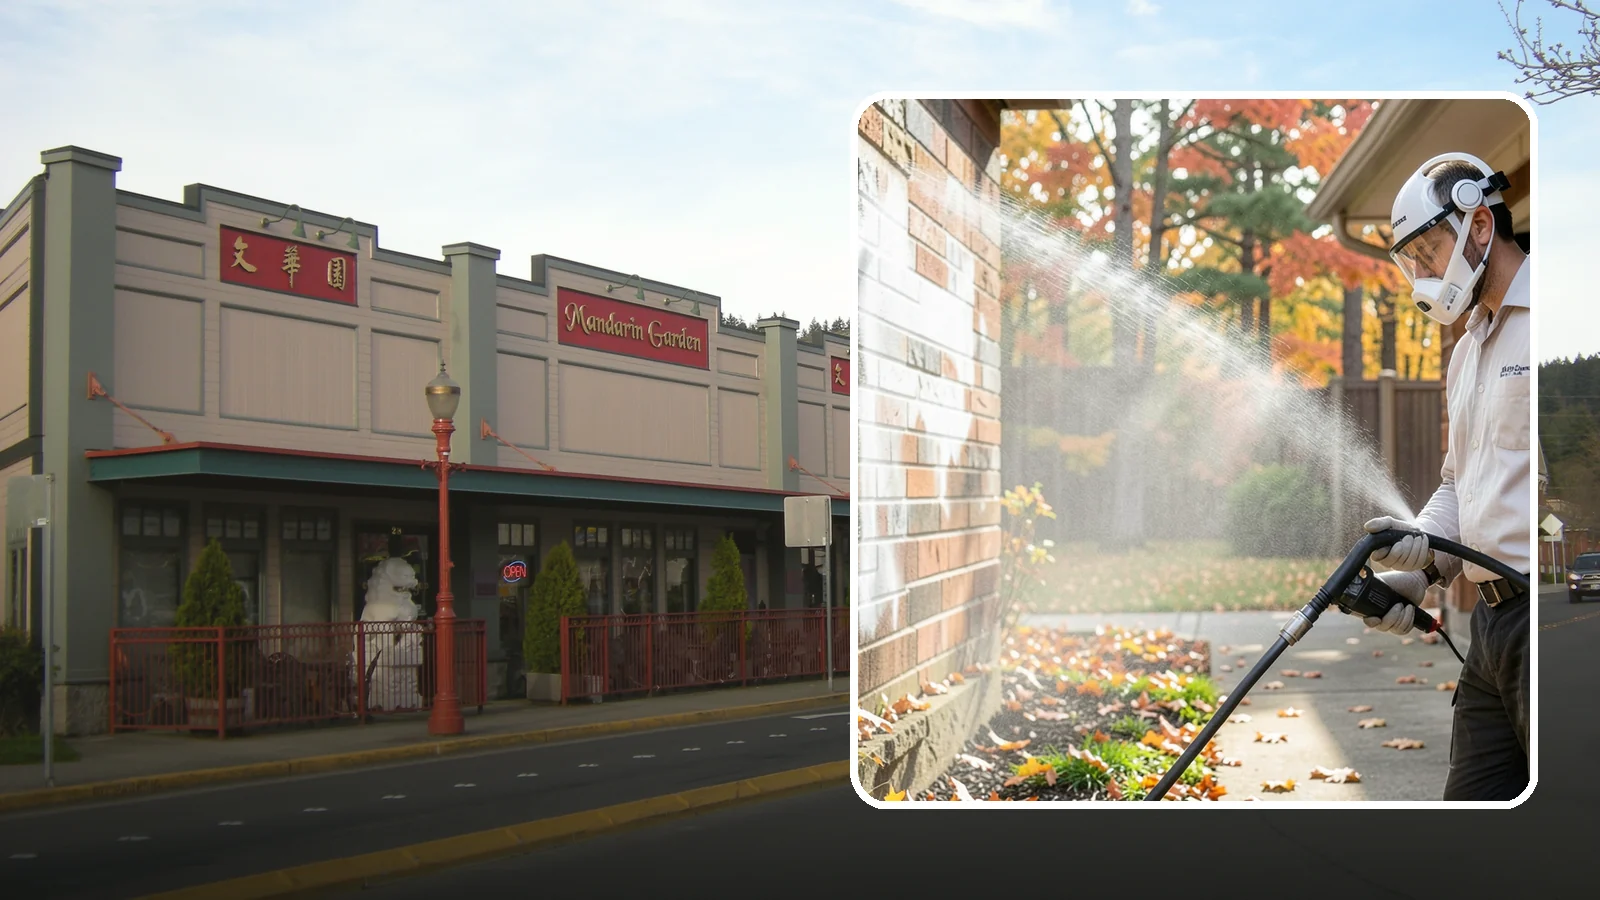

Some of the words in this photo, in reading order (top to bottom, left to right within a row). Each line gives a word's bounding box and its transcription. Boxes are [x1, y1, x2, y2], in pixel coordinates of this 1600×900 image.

[230, 235, 346, 291] 文華園
[564, 302, 644, 341] Mandarin
[647, 320, 701, 352] Garden
[503, 565, 527, 578] OPEN
